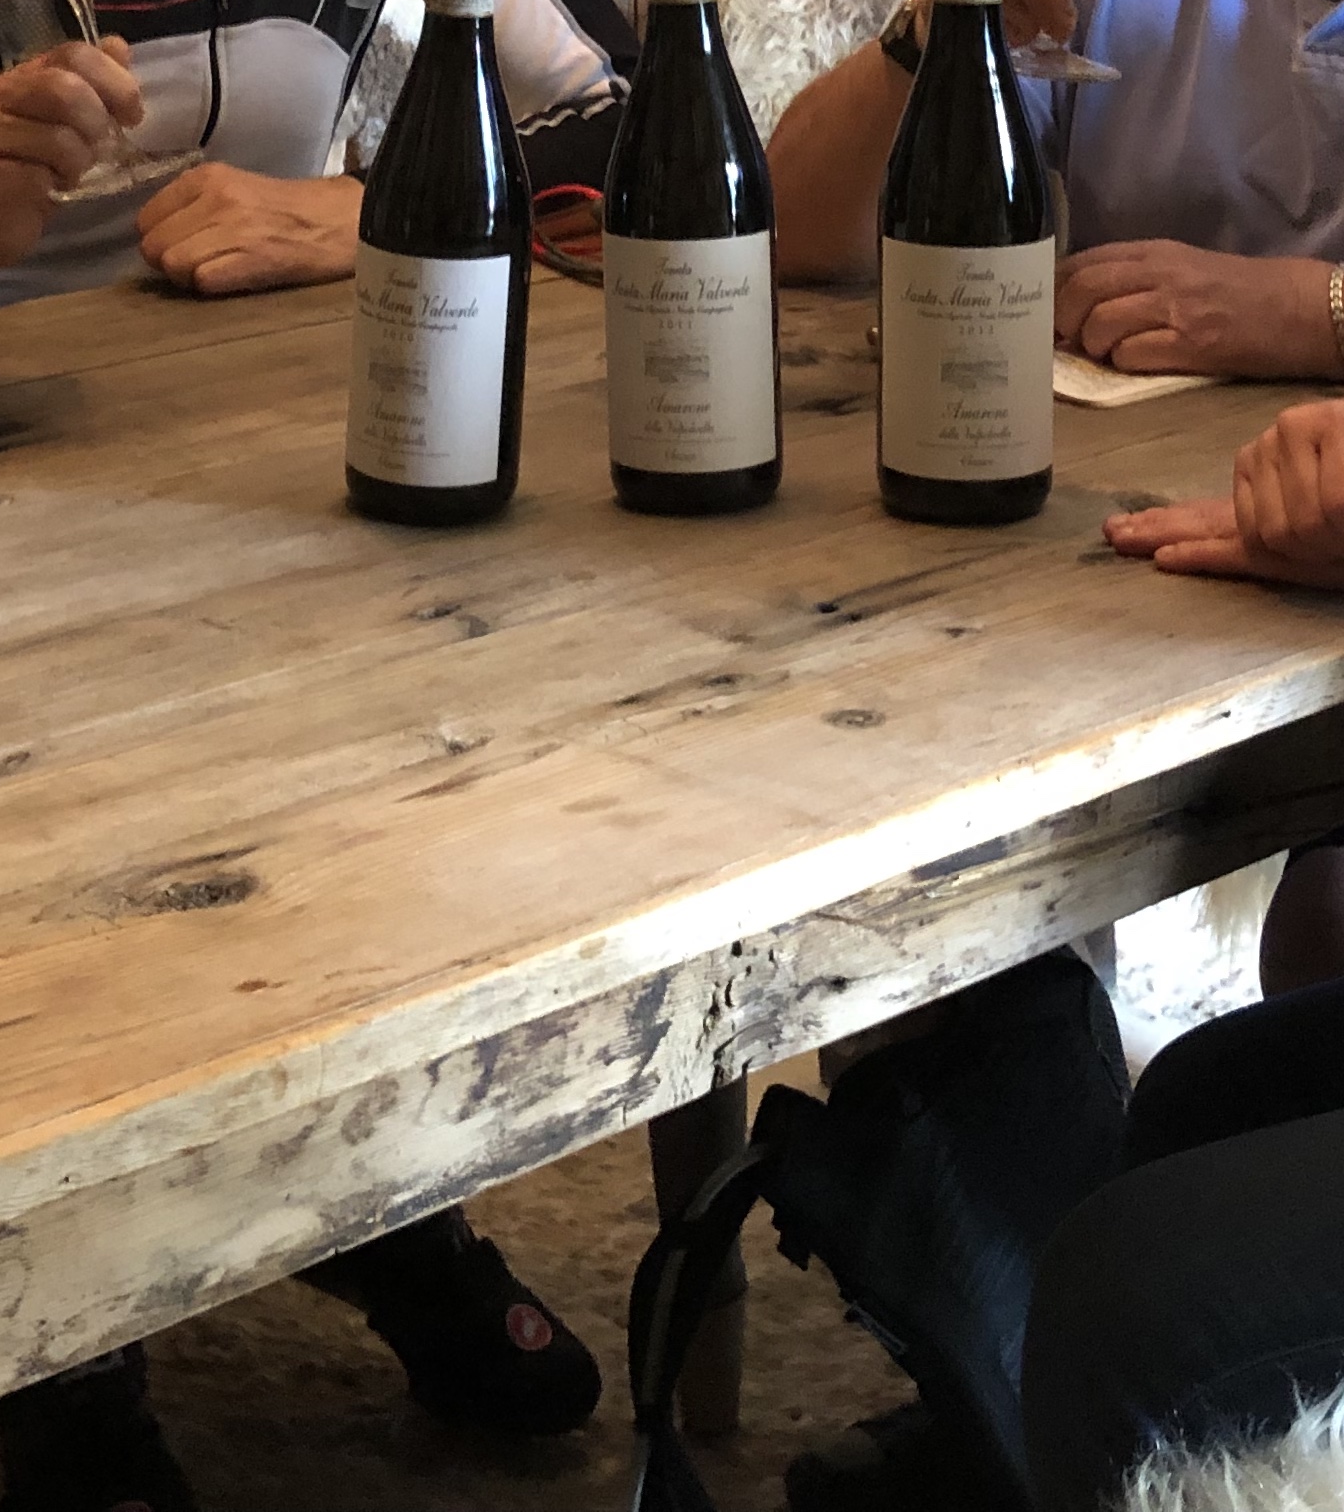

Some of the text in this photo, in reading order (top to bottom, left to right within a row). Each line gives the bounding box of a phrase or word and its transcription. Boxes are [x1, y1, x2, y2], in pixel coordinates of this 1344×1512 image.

[642, 280, 689, 301] Maria
[698, 276, 751, 301] Valverde
[900, 279, 938, 305] Santa
[940, 283, 992, 308] Maria
[374, 288, 413, 316] Maria
[421, 294, 479, 319] Valverde
[942, 399, 1008, 420] Amarone
